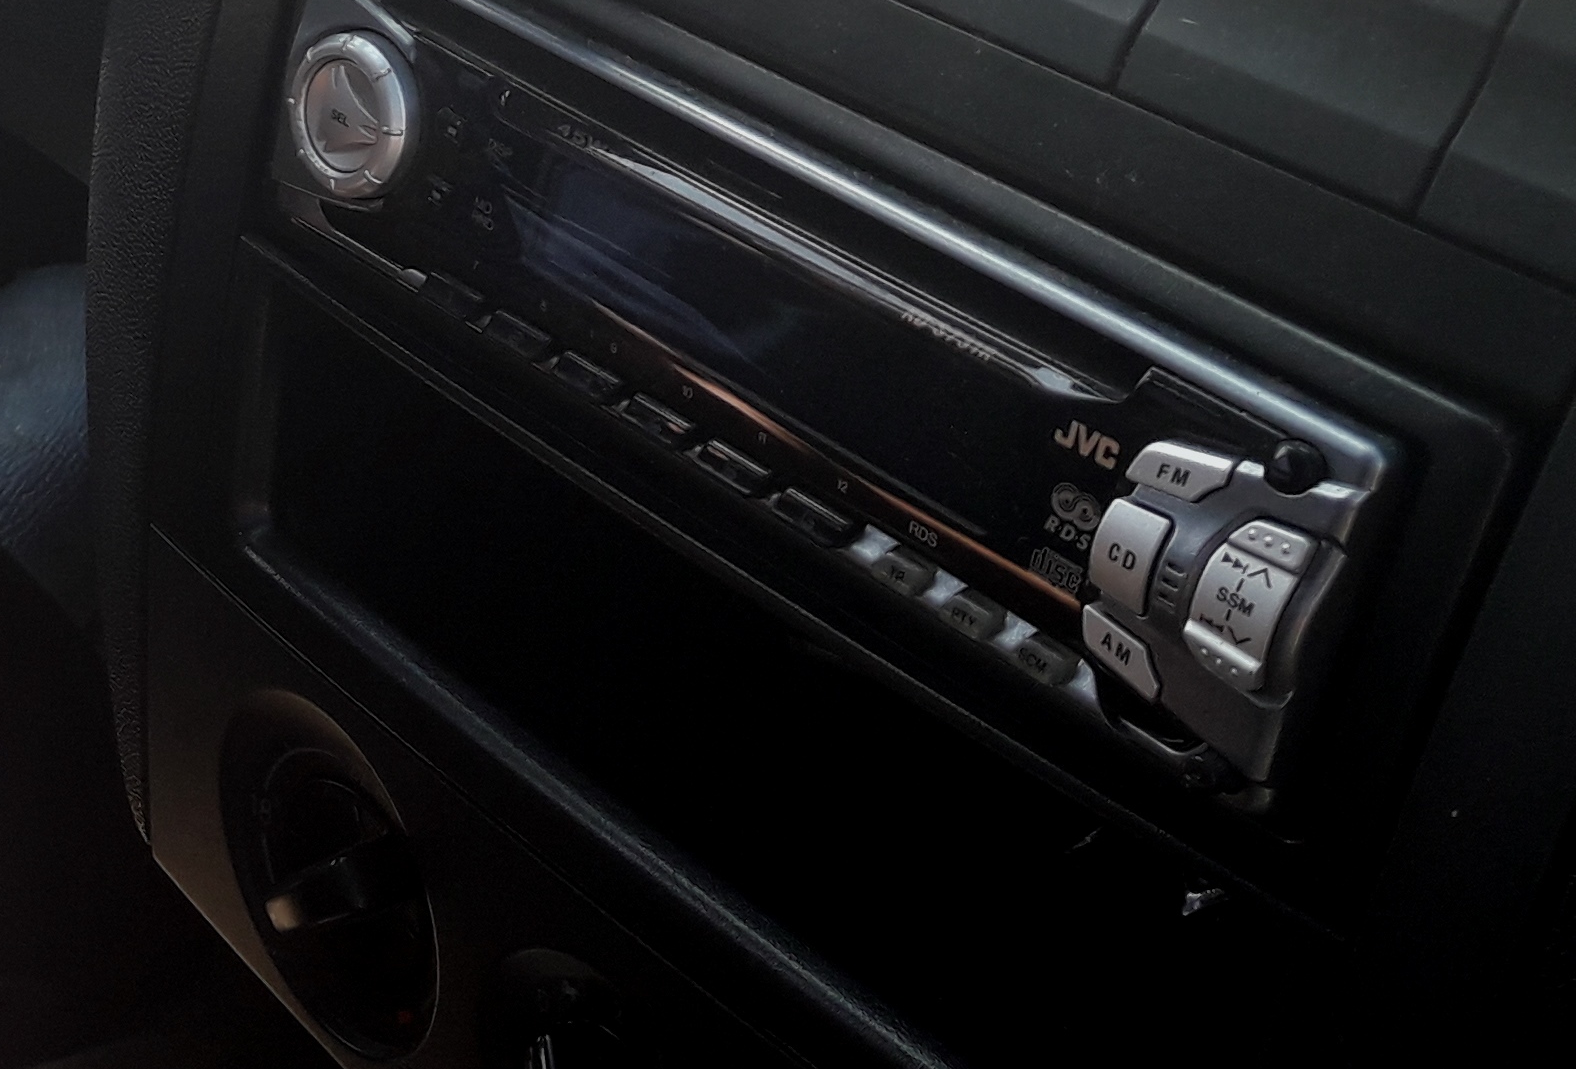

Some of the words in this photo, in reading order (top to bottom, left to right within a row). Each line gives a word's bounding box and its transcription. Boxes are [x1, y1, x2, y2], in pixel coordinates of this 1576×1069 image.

[1052, 419, 1122, 471] JVC
[1156, 464, 1191, 488] FM
[908, 519, 939, 548] RDS
[1107, 543, 1138, 571] CD
[1216, 586, 1255, 617] SSM
[1100, 631, 1132, 667] AM
